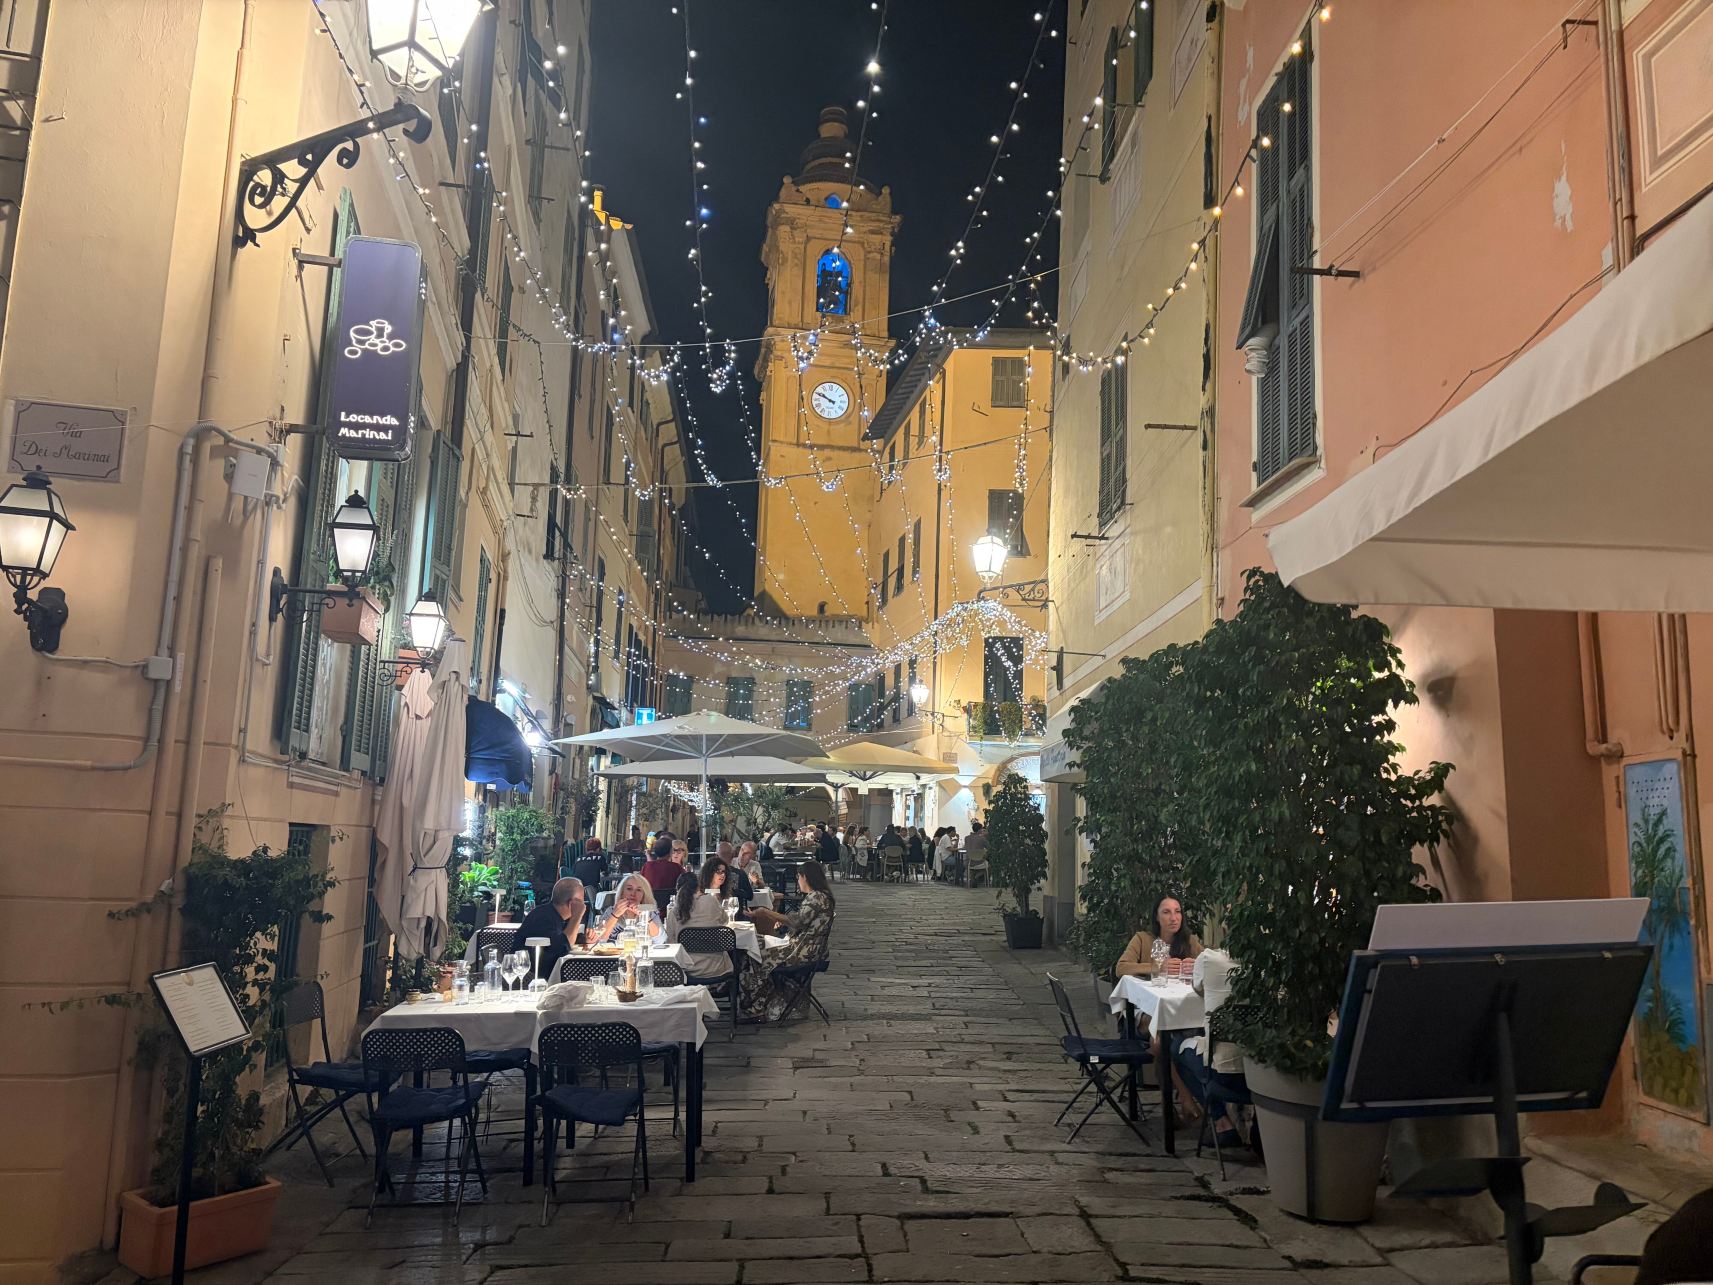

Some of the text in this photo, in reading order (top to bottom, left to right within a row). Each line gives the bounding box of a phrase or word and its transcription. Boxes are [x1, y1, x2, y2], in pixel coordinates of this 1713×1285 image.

[340, 411, 399, 426] Locanda
[55, 421, 84, 439] Via
[338, 427, 393, 440] Marinai
[23, 439, 111, 463] Dei Marinai
